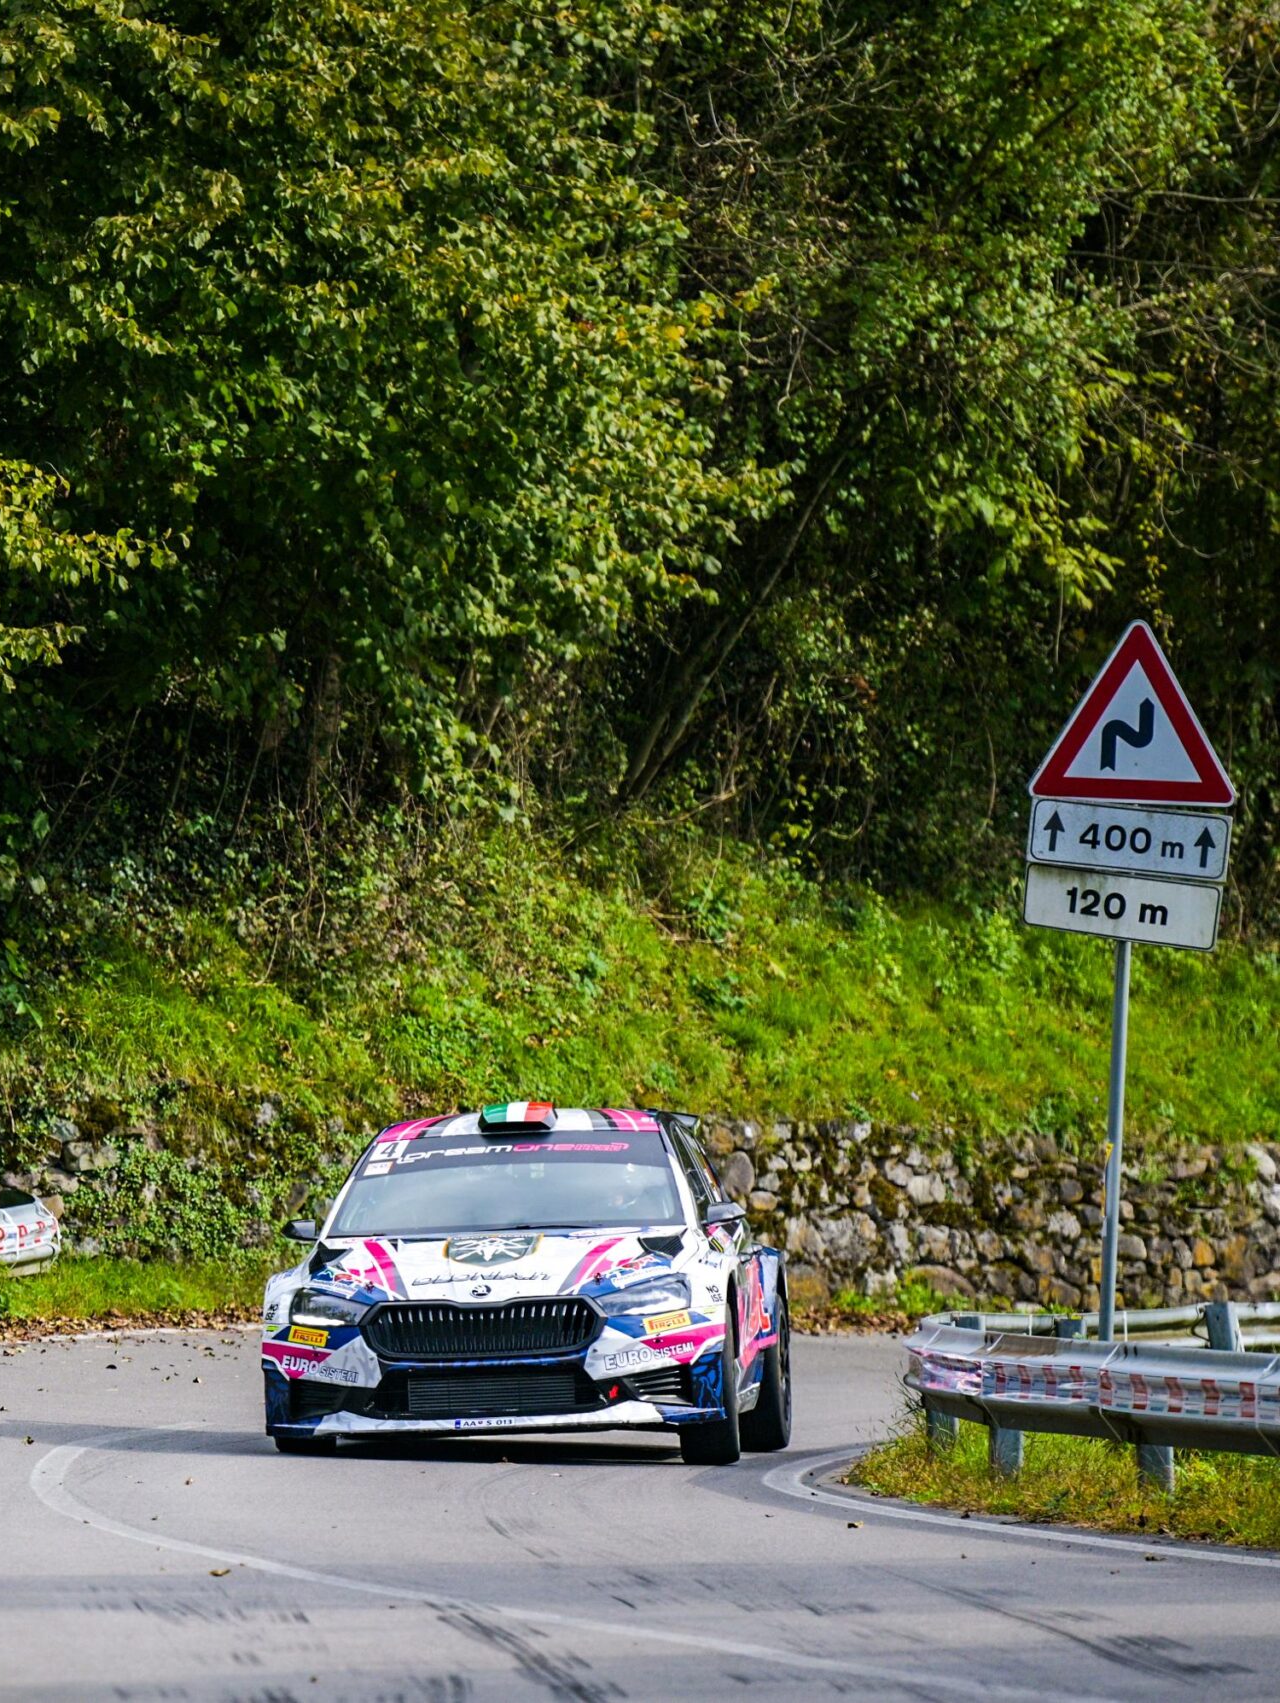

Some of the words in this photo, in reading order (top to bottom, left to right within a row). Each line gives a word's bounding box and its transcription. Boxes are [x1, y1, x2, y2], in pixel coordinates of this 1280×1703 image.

[1079, 823, 1152, 854] 400
[1160, 839, 1185, 860] m
[1066, 886, 1126, 920] 120
[1138, 901, 1169, 926] m
[380, 1142, 399, 1157] 4
[706, 1285, 719, 1294] NO
[648, 1313, 687, 1331] PIRELLI
[293, 1328, 325, 1344] PIRELLI
